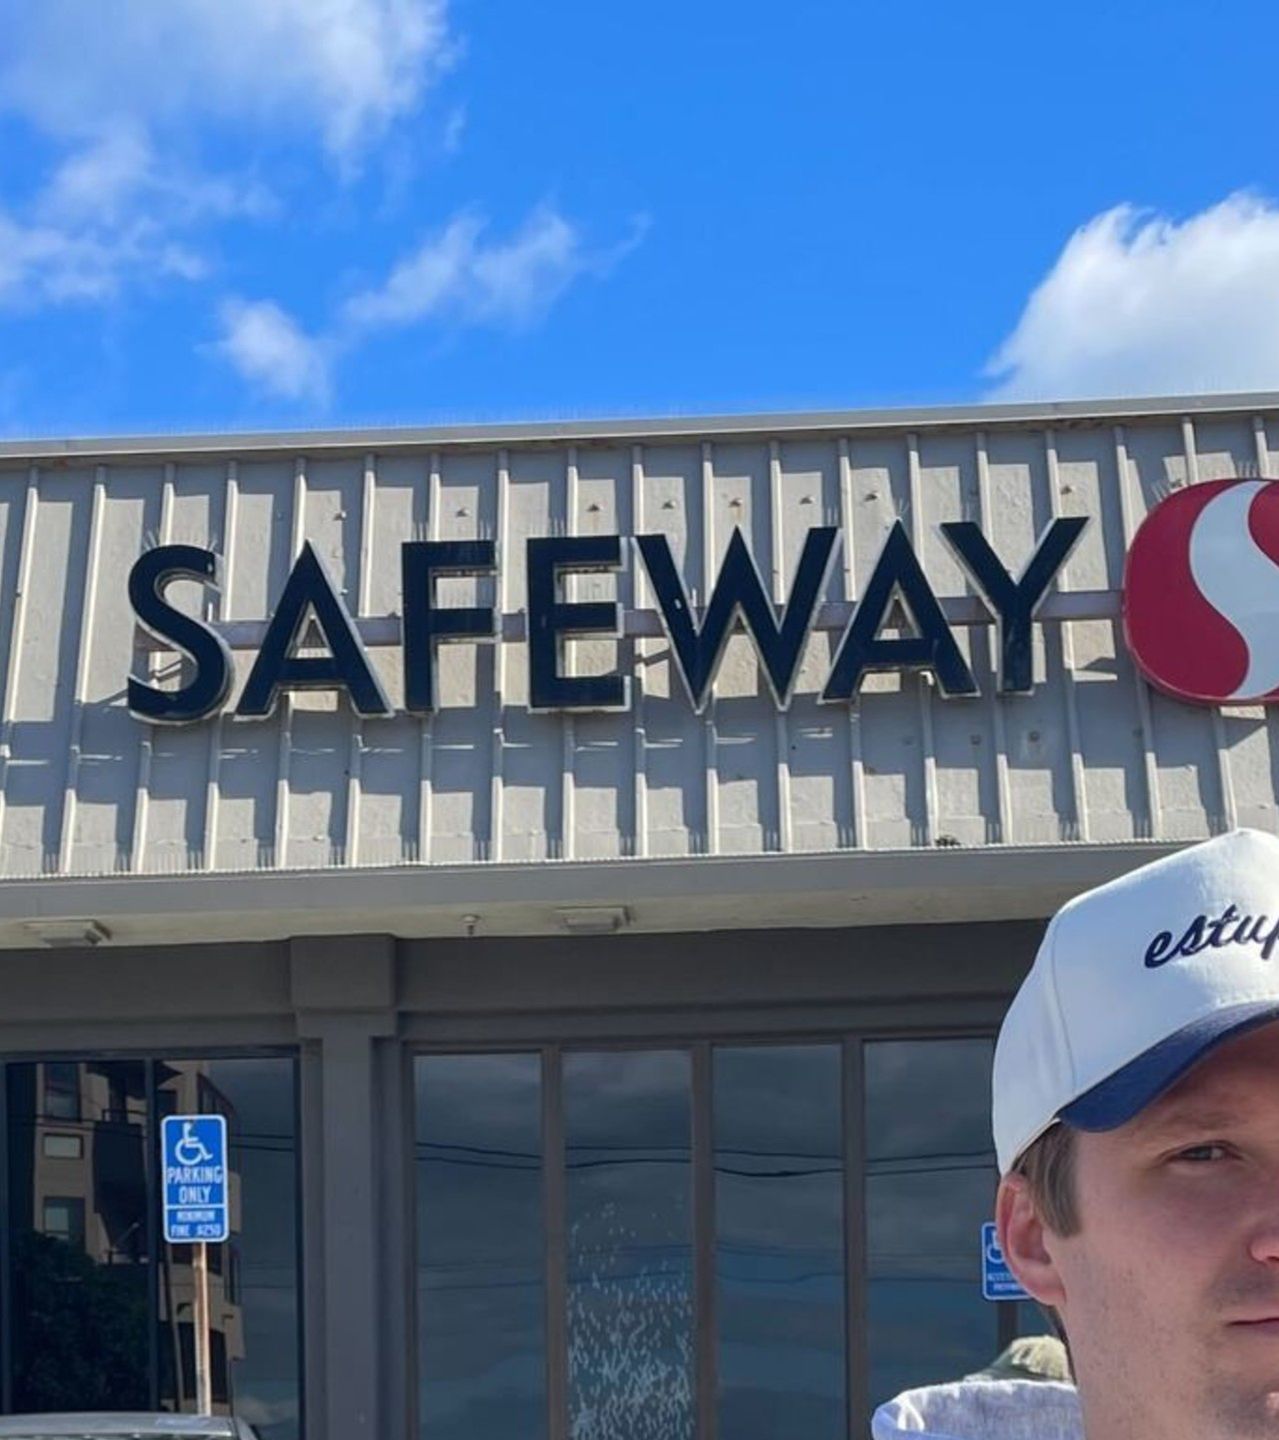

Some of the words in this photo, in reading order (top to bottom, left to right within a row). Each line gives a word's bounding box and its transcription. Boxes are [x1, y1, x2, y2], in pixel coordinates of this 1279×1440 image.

[127, 516, 1092, 724] SAFEWAY
[167, 1166, 223, 1184] PARKING
[178, 1185, 211, 1204] ONLY
